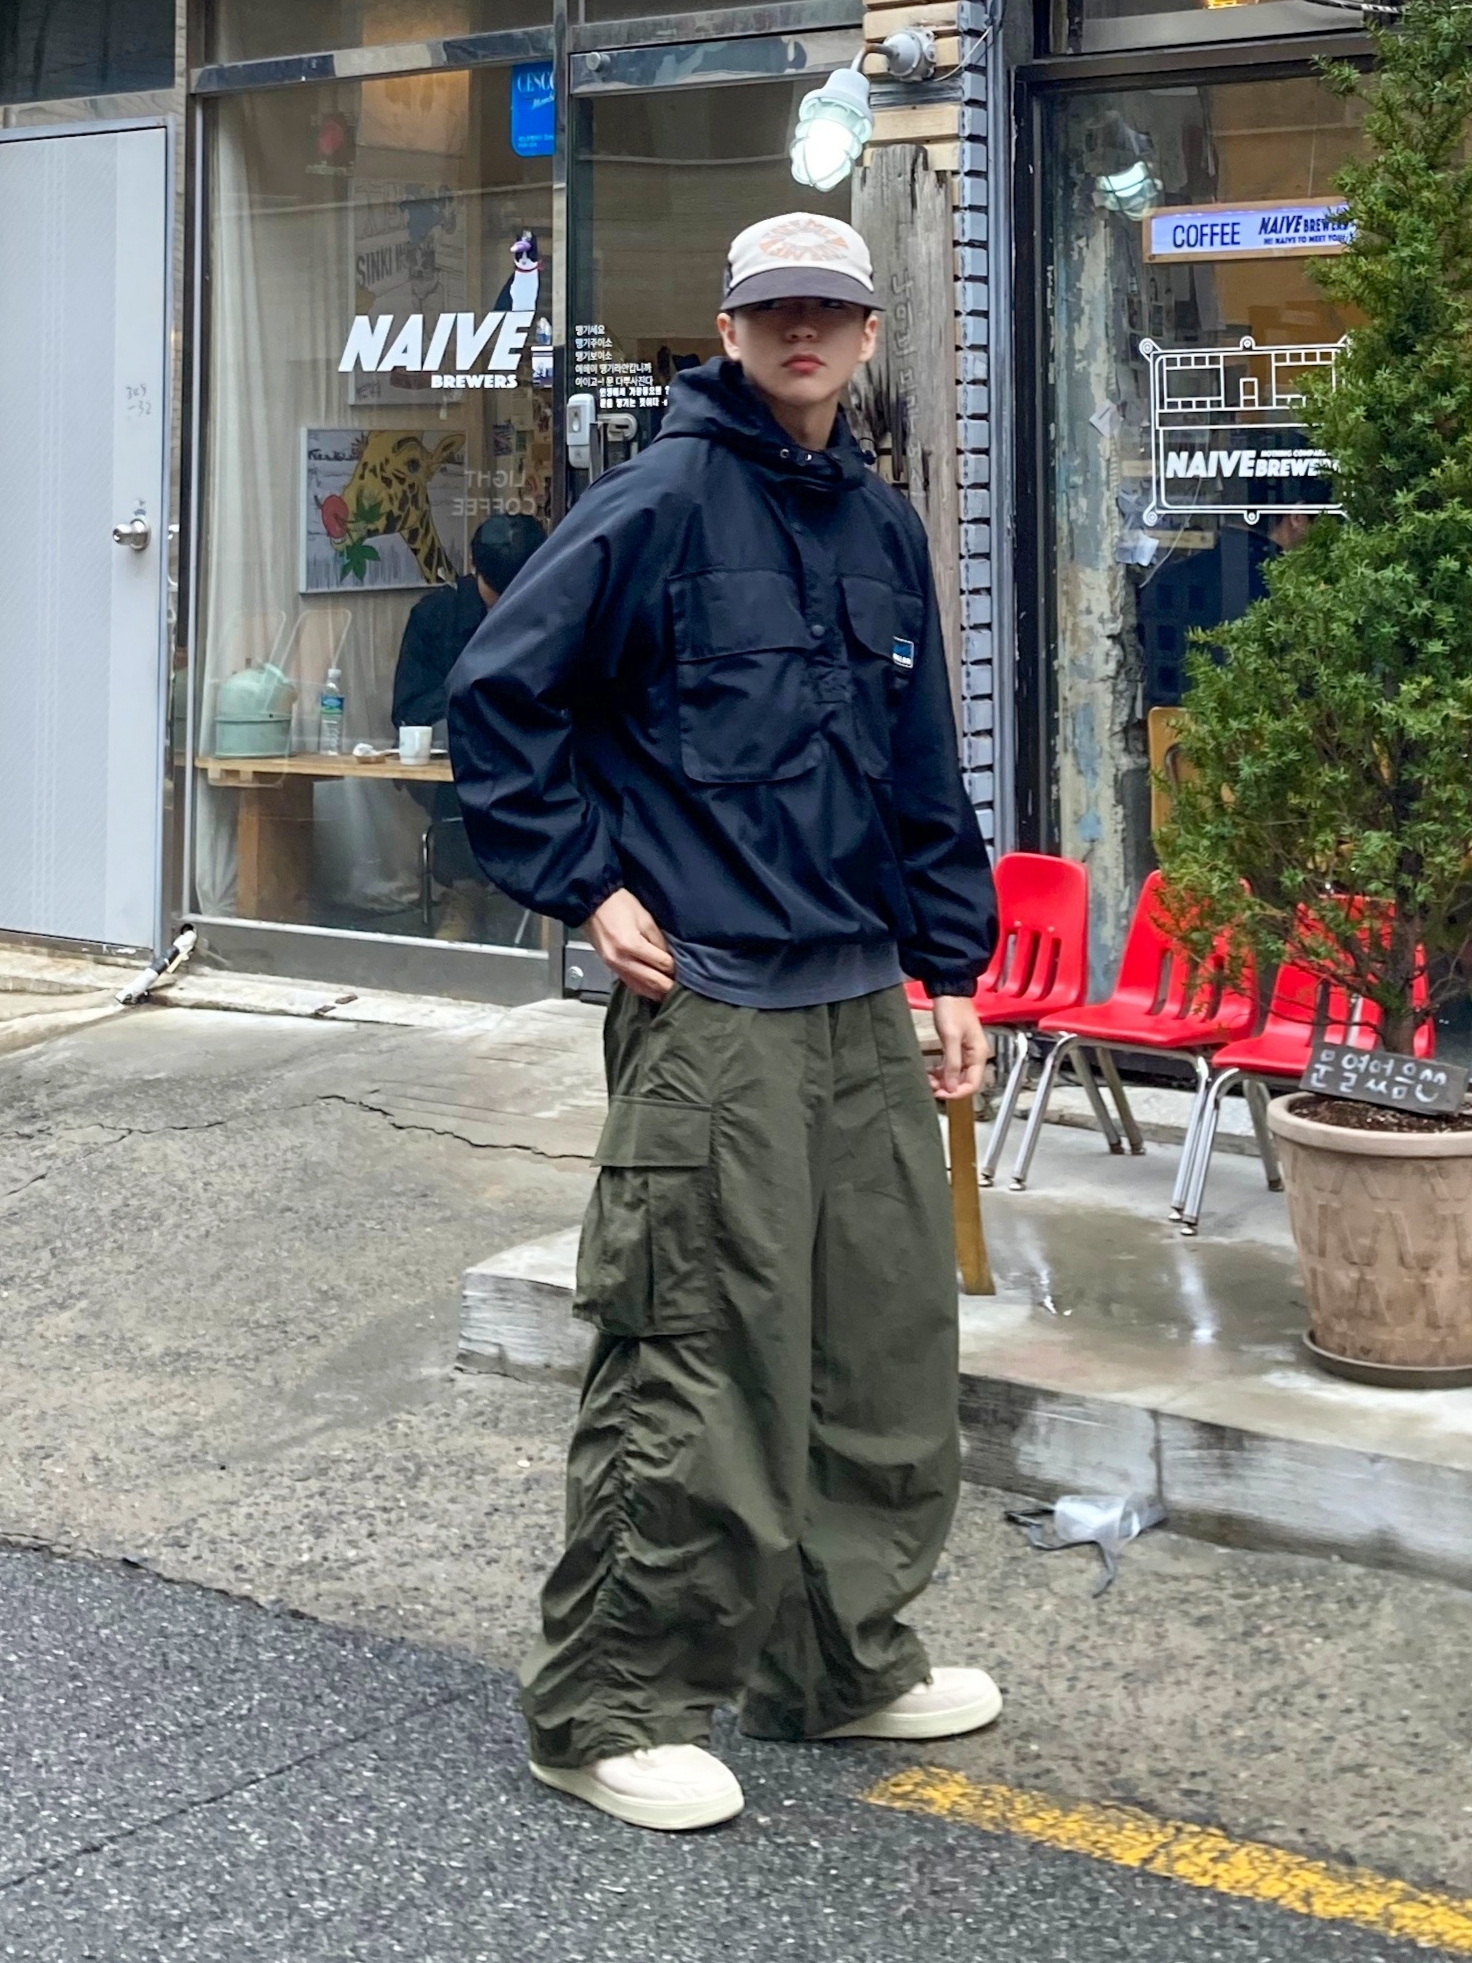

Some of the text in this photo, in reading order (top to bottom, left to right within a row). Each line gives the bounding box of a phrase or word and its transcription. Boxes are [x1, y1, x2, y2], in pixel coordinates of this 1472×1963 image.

[1172, 222, 1241, 249] COFFEE
[1258, 215, 1303, 235] NAIVE
[338, 310, 536, 373] NAIVE
[430, 374, 518, 390] BREWERS
[1166, 450, 1257, 479] NAIVE
[1310, 1049, 1336, 1088] 문
